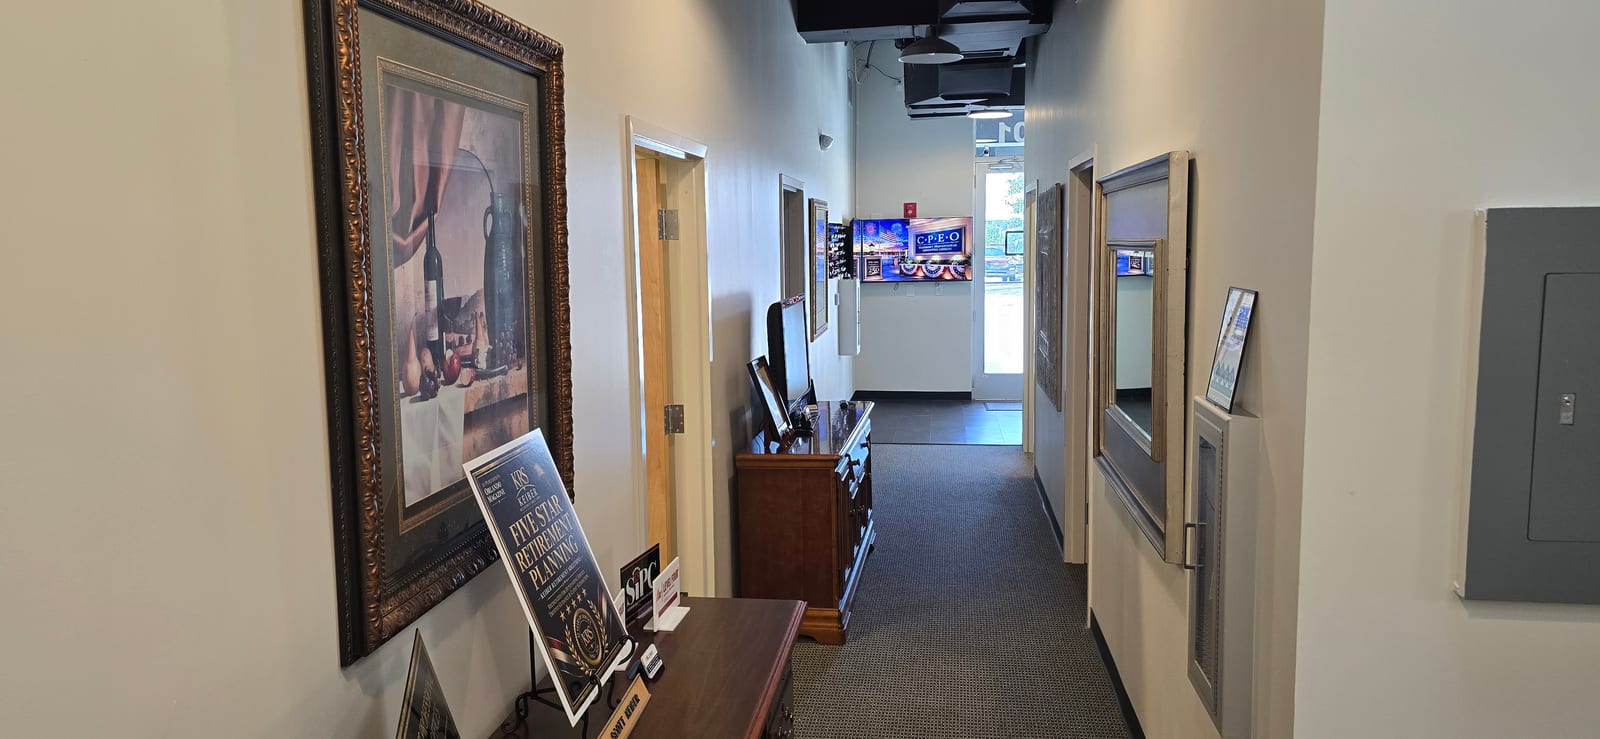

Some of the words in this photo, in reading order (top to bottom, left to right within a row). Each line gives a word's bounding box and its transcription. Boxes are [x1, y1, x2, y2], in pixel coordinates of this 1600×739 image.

[510, 467, 530, 490] KRS
[517, 487, 538, 507] KEIBER
[509, 512, 539, 547] FIVE
[535, 494, 563, 527] STAR
[515, 512, 573, 573] RETIREMENT
[528, 534, 579, 591] PLANNING
